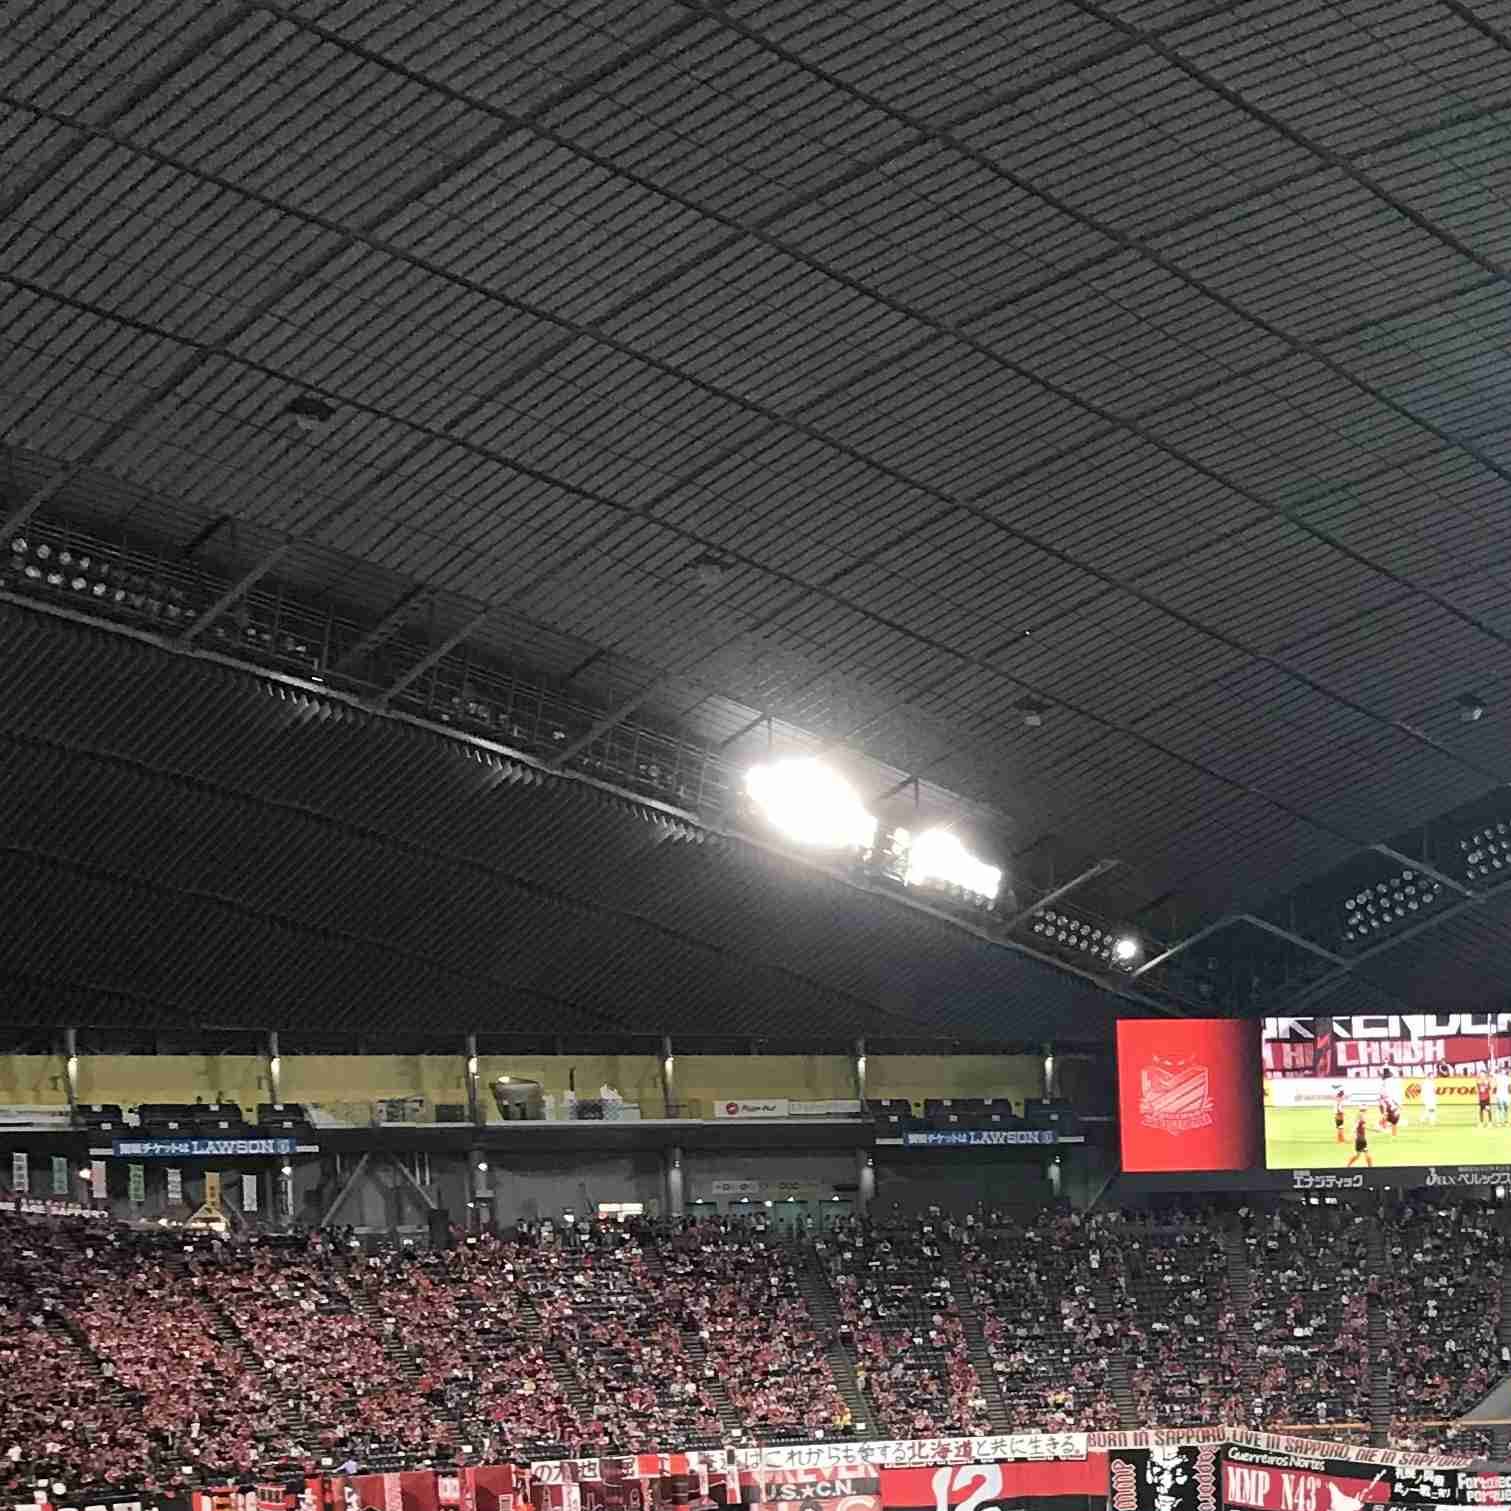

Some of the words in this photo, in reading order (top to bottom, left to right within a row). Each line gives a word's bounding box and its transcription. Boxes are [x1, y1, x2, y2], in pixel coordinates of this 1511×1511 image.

[970, 1131, 1040, 1145] LAWSON
[191, 1140, 274, 1155] LAWSON
[1227, 1466, 1271, 1508] MMP
